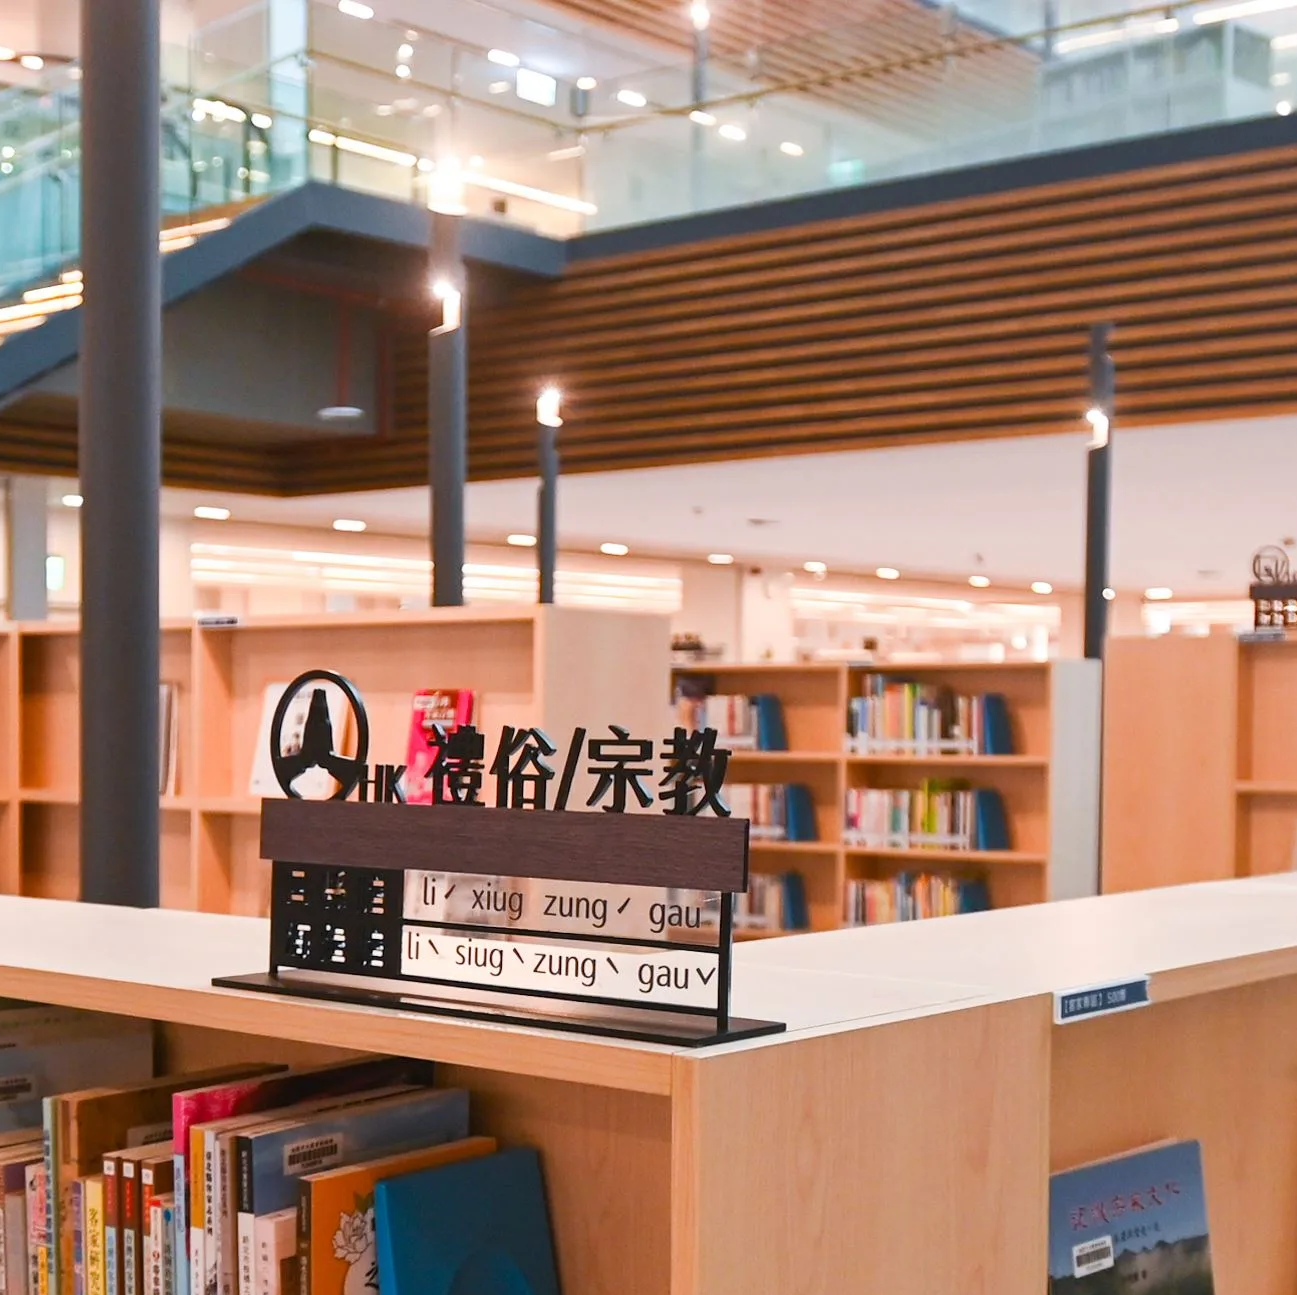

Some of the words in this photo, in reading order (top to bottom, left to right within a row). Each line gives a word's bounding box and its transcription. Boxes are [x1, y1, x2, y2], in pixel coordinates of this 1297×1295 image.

[424, 722, 733, 818] 禮俗/宗教
[471, 884, 524, 920] xiug
[648, 902, 701, 934] gau
